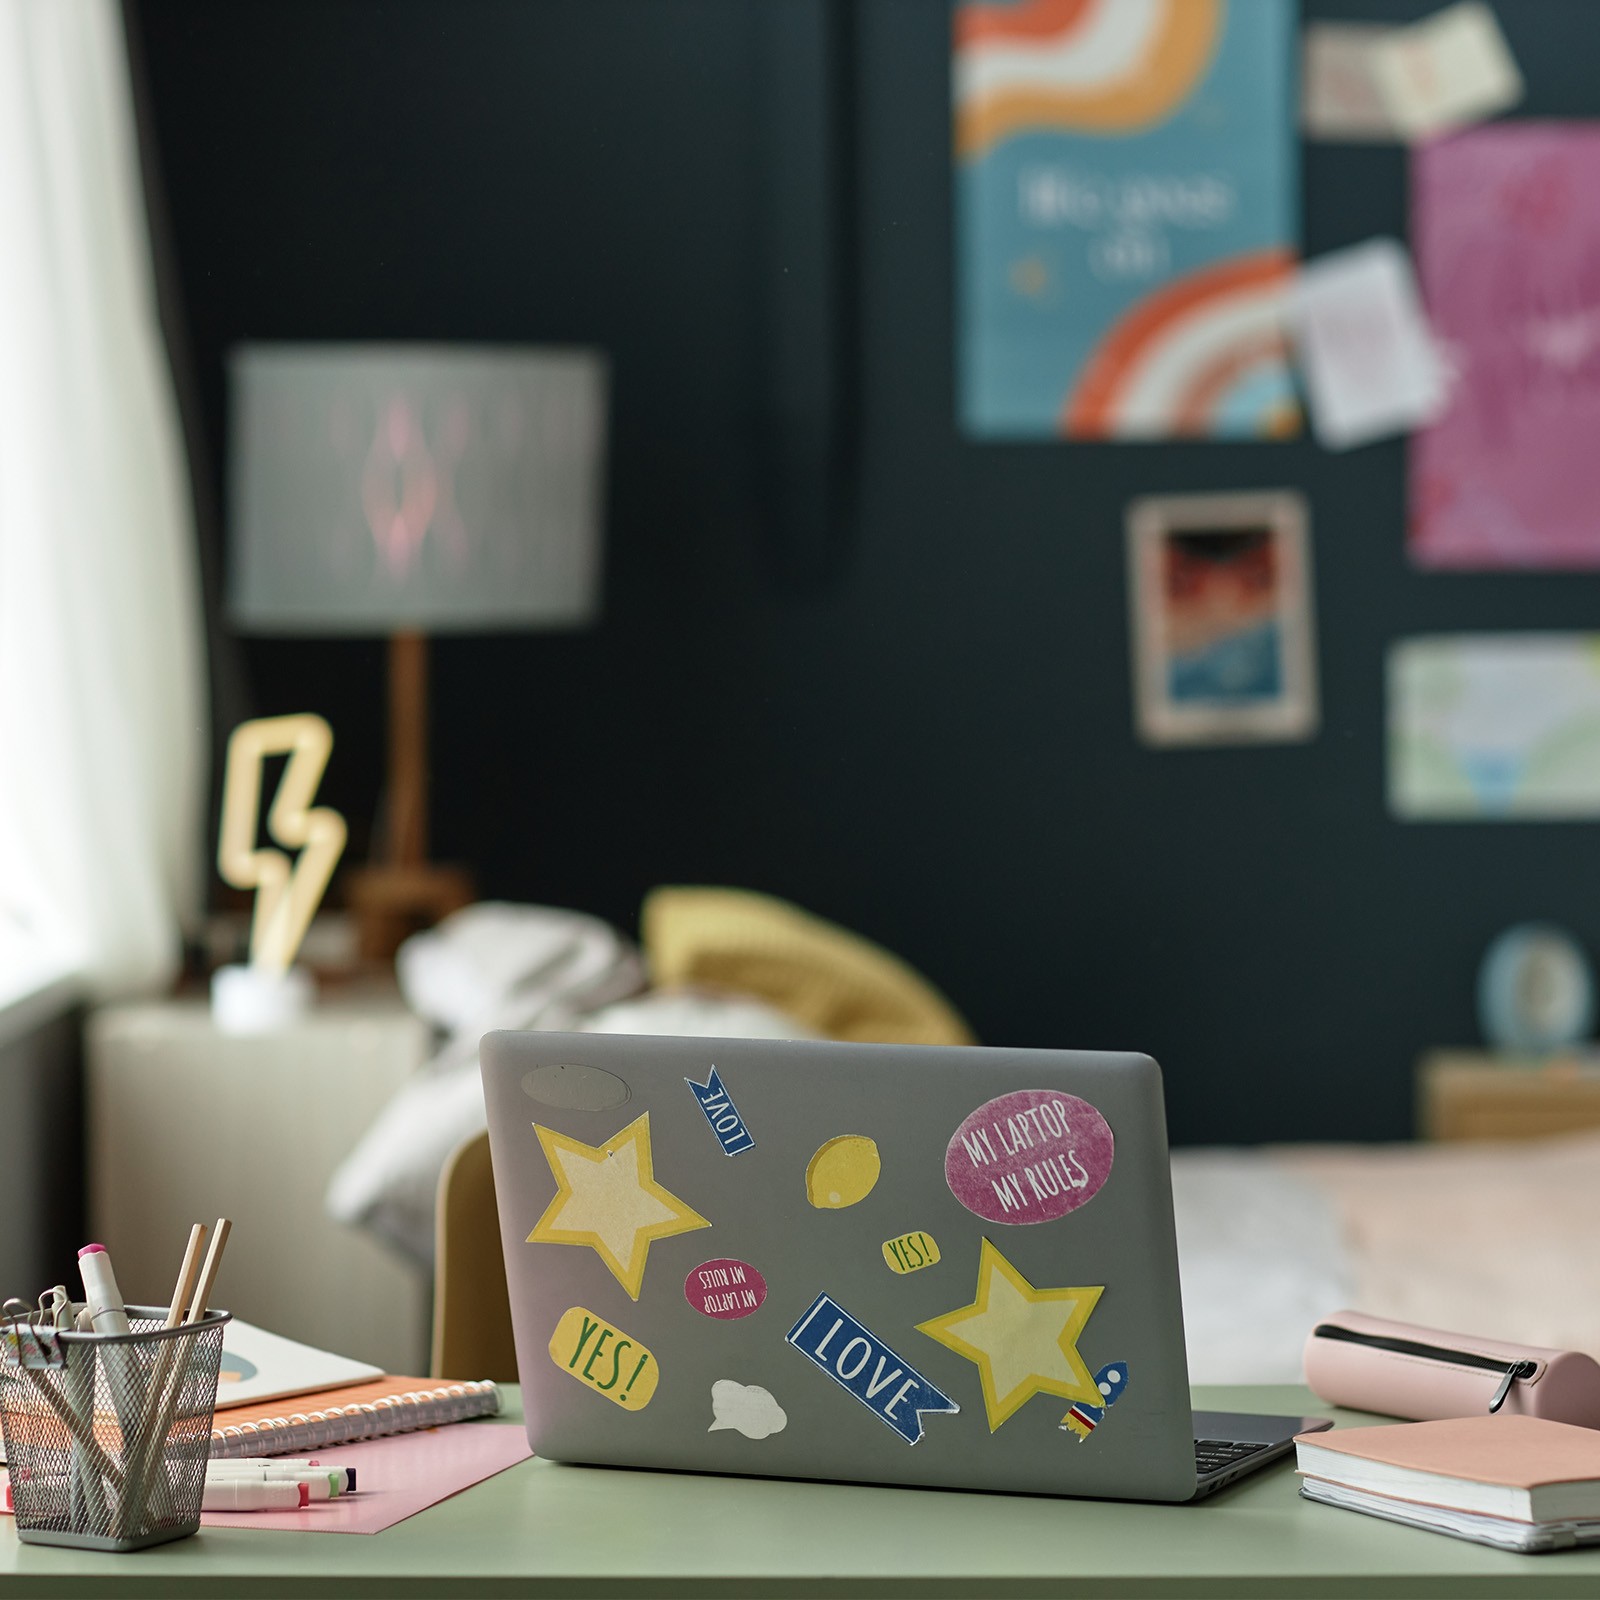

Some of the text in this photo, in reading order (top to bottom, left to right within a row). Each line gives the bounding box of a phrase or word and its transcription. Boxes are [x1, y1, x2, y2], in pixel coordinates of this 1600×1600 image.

[701, 1087, 746, 1145] LOVE
[961, 1099, 1071, 1169] MY LAPTOP
[991, 1149, 1089, 1213] MY RULES
[698, 1265, 746, 1290] MY RULES
[887, 1233, 933, 1271] YES!
[703, 1289, 758, 1314] MY LAPTOP
[569, 1316, 649, 1402] YES!
[814, 1318, 920, 1421] LOVE
